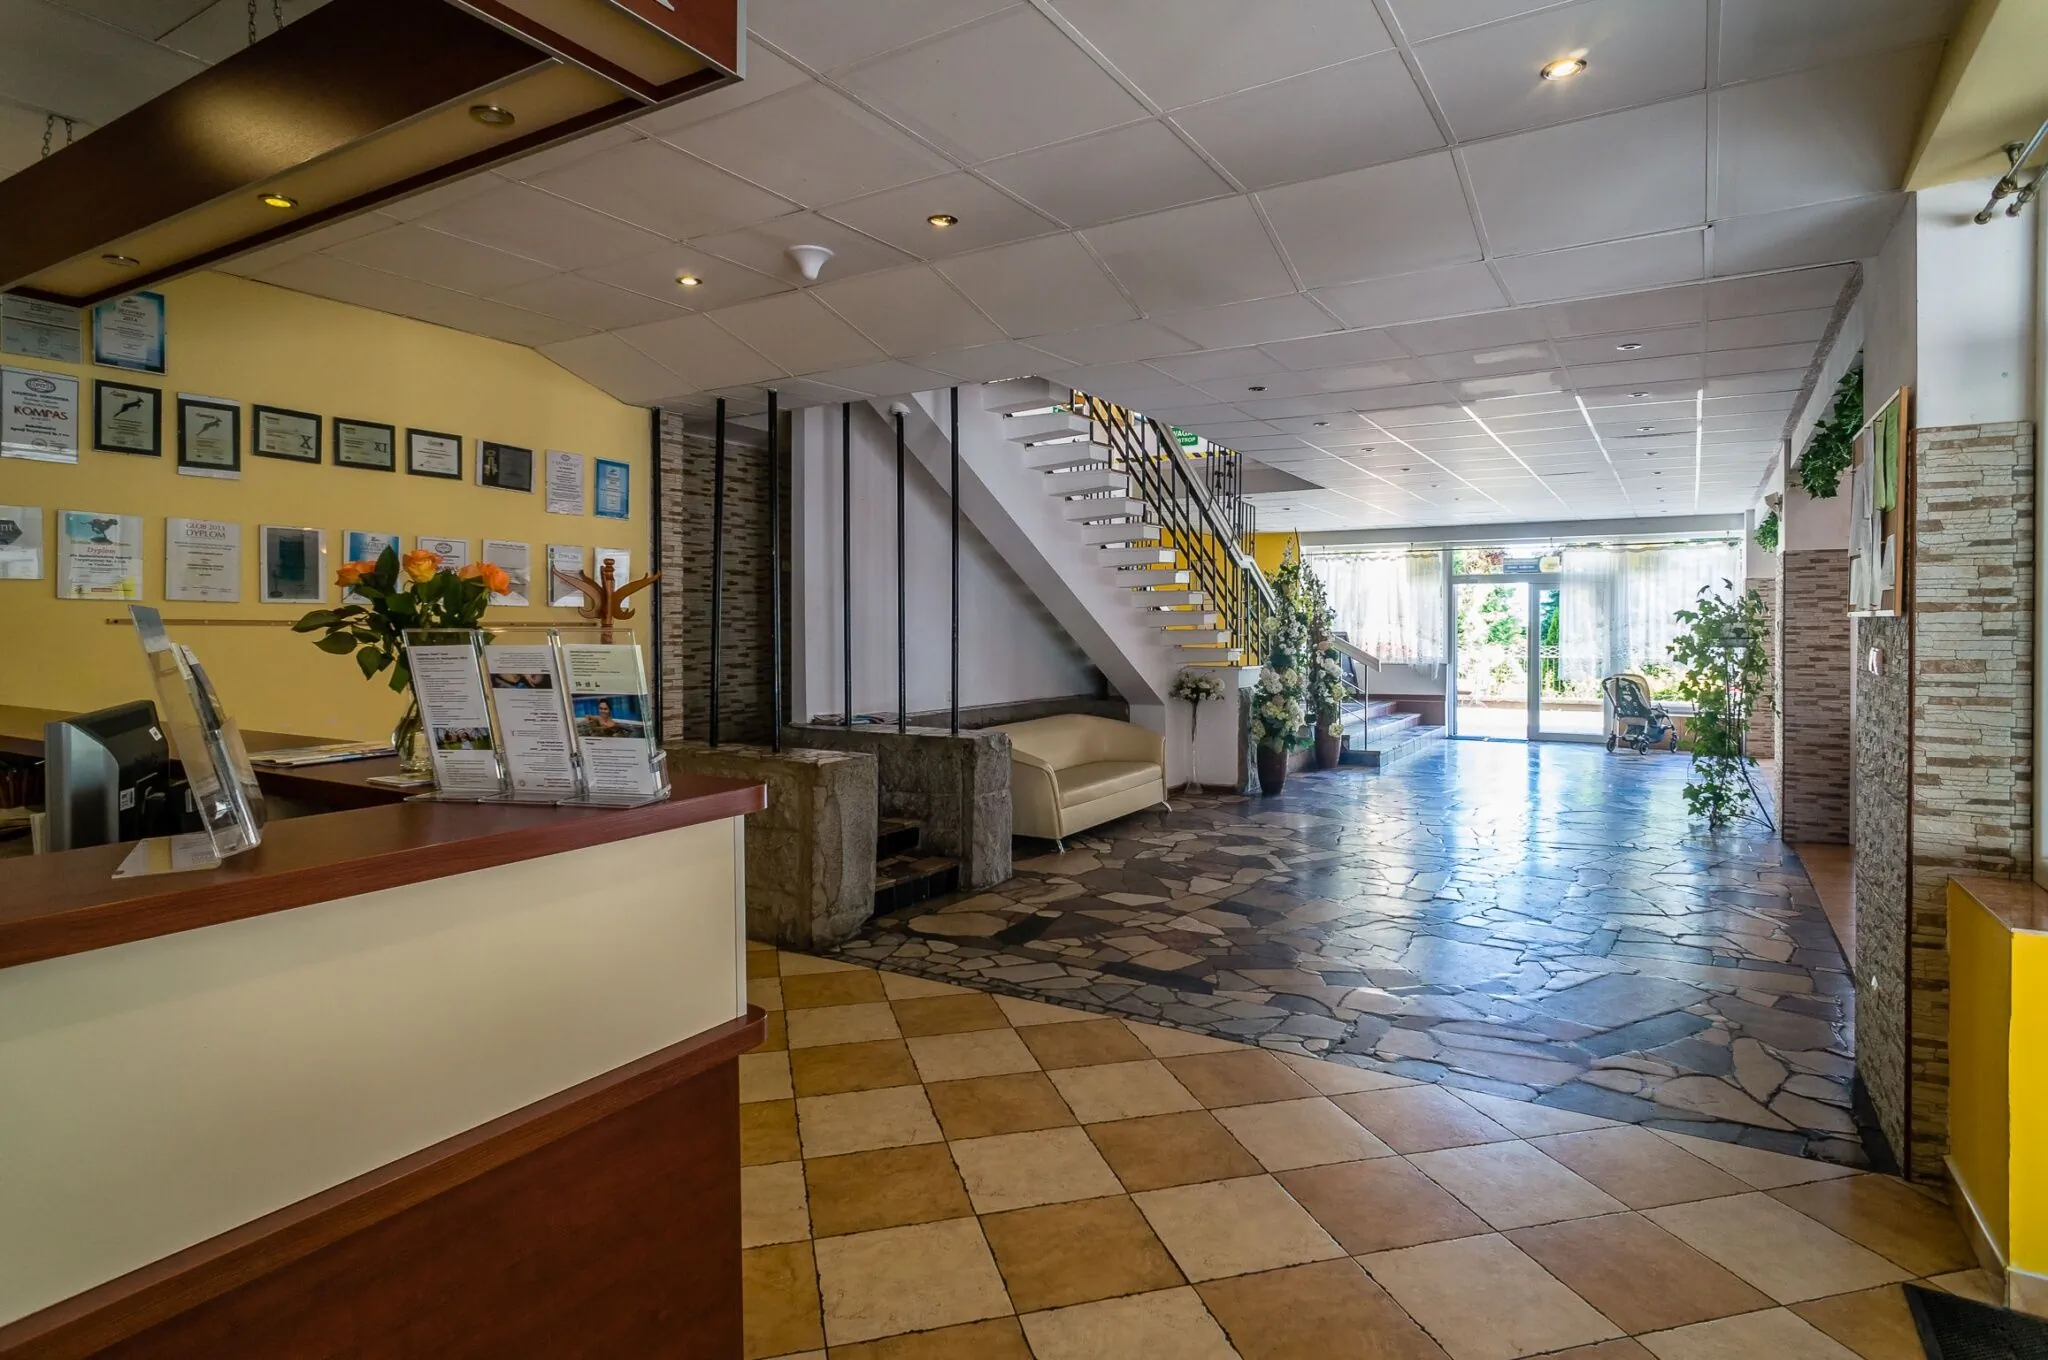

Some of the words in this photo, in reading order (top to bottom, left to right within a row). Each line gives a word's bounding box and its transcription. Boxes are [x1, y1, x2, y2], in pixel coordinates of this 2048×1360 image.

[14, 405, 69, 421] KOMPAS
[300, 434, 313, 450] X
[186, 529, 226, 539] DYPLOM
[87, 547, 116, 555] Dyplom
